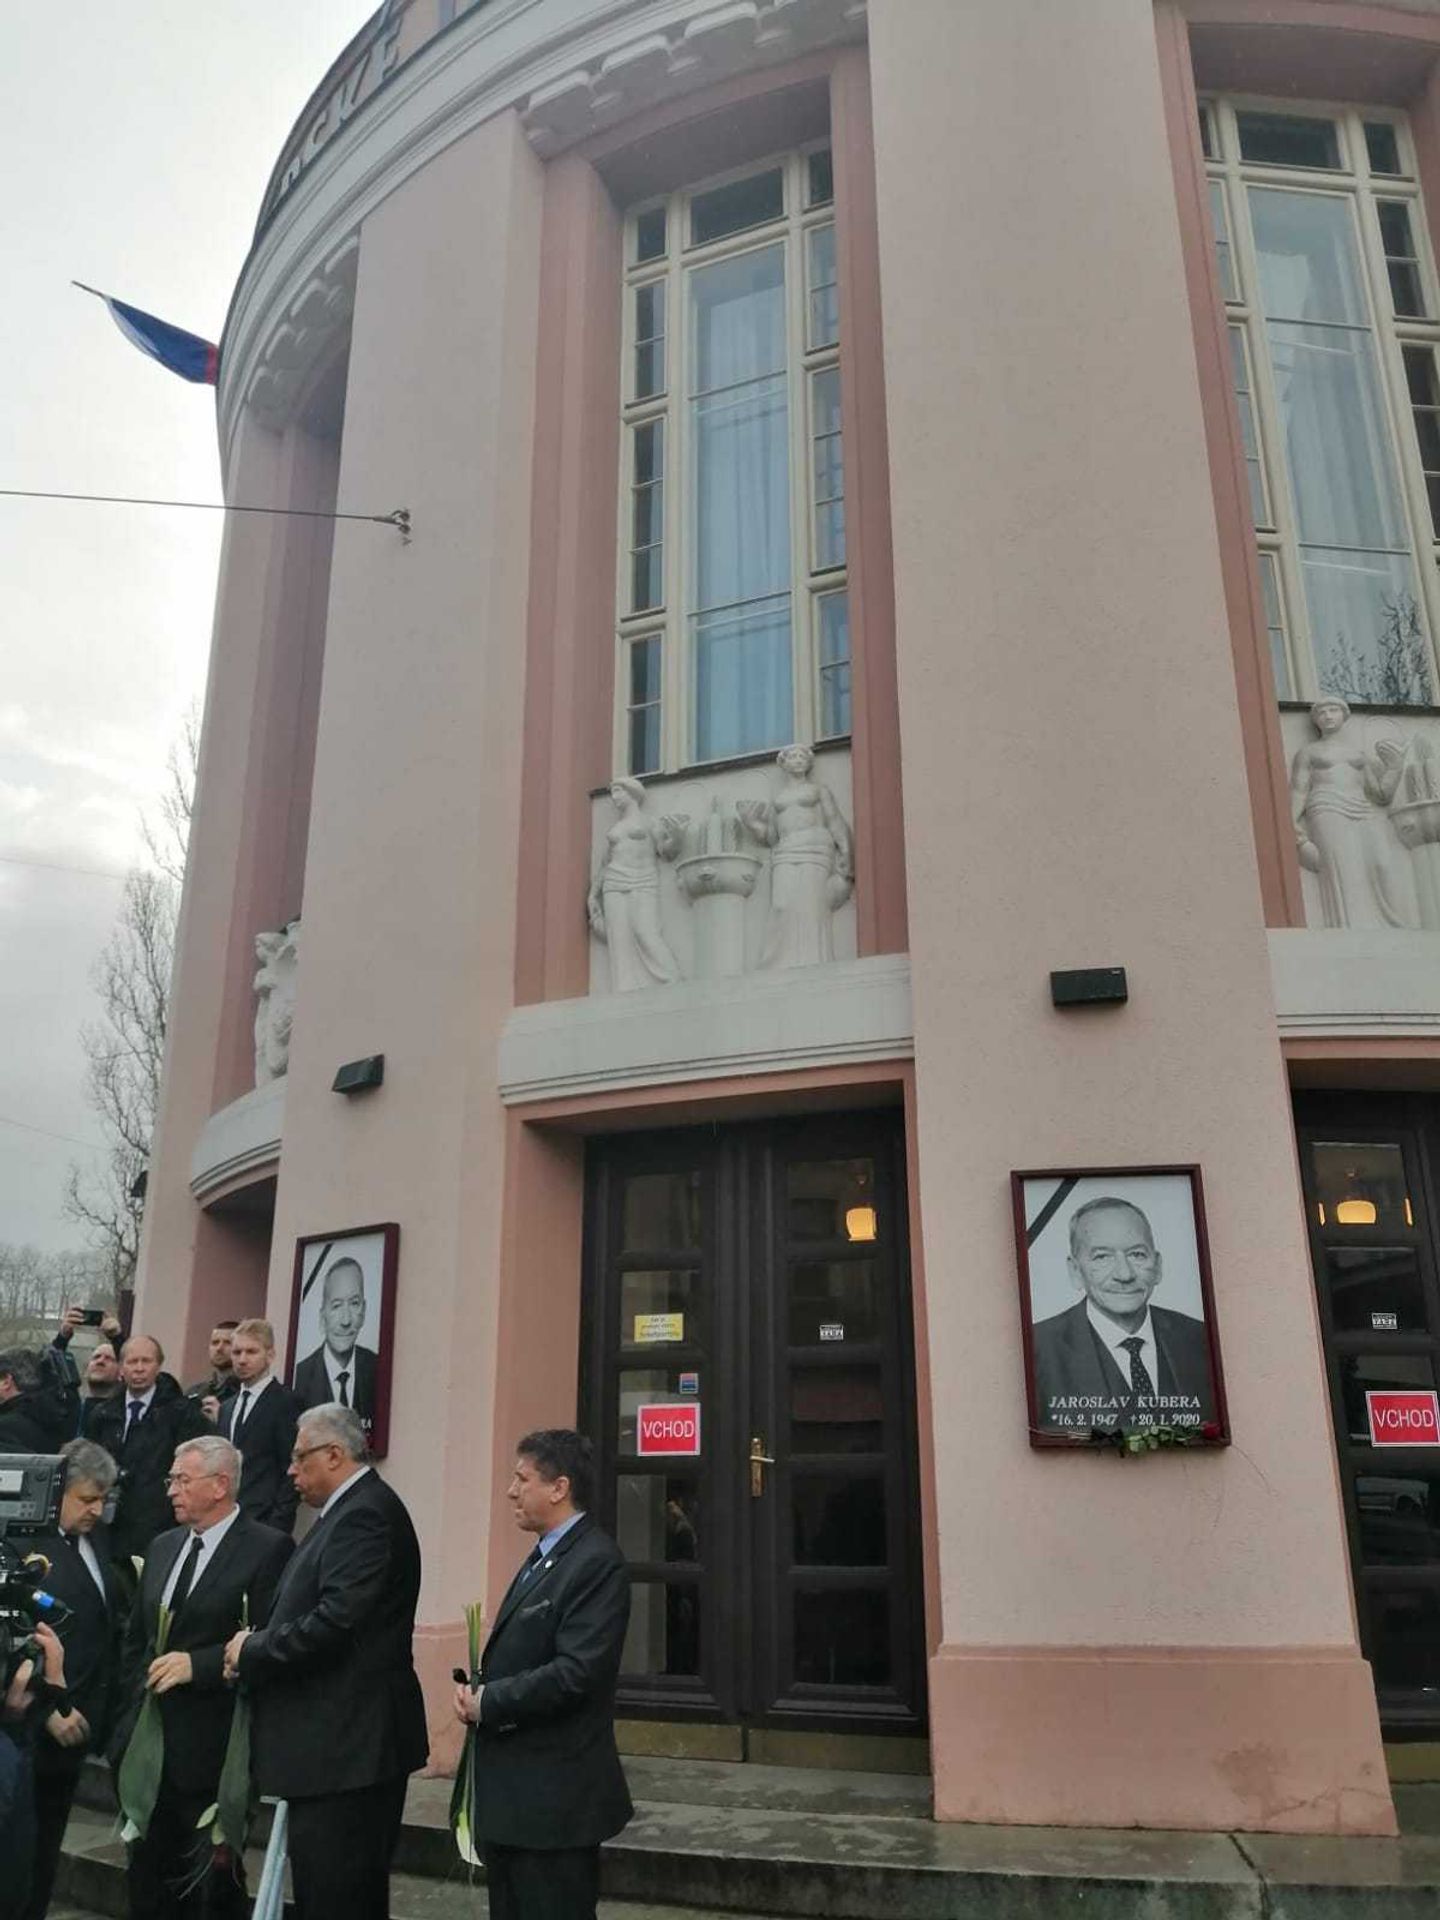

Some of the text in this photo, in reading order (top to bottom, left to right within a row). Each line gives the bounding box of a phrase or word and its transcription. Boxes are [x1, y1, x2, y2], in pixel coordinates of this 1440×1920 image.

[1049, 1395, 1201, 1409] JAROSLAV KUBERA
[1076, 1413, 1087, 1426] 2.
[1090, 1413, 1119, 1426] 1947
[1171, 1412, 1201, 1427] 2020
[1373, 1408, 1434, 1429] VCHOD
[642, 1420, 696, 1440] VCHOD
